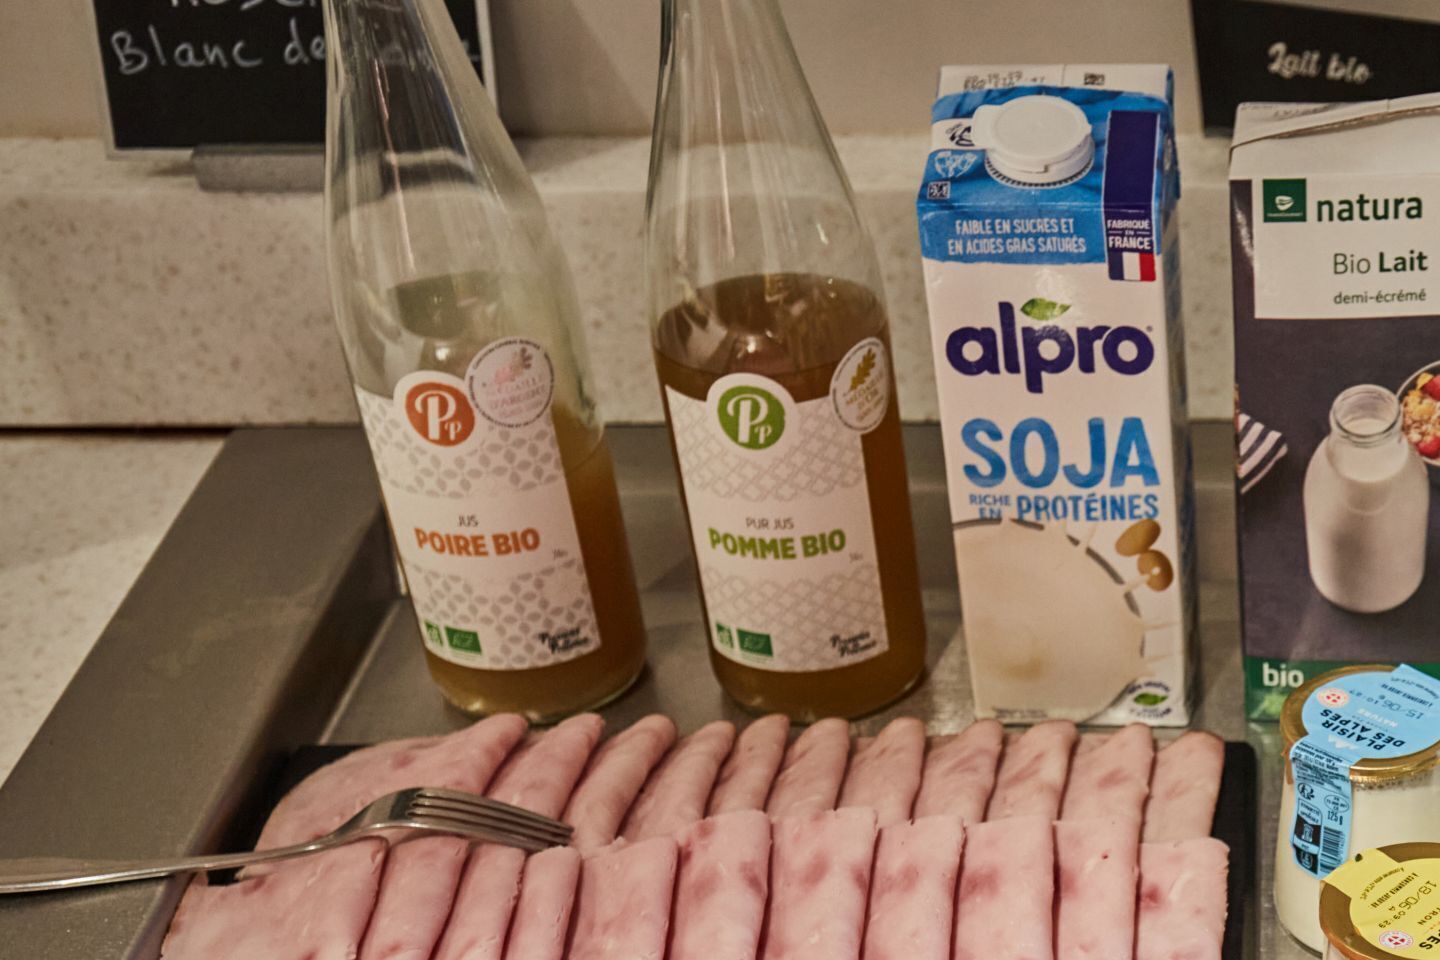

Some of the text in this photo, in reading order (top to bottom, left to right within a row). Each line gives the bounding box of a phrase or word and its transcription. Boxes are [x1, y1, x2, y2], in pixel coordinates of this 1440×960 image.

[110, 25, 263, 76] Blanc
[284, 17, 326, 65] de
[1326, 55, 1371, 84] bio
[1316, 196, 1424, 223] natura
[956, 217, 1075, 236] FAIBLE EN SUCRES ET
[1107, 218, 1151, 230] FABRIQUÉ
[948, 235, 1086, 256] EN ACIDES GRAS SATURÉS
[1109, 236, 1151, 250] FRANCE
[1333, 249, 1429, 275] Bio Lait
[1333, 288, 1427, 306] demi-écrémé
[946, 302, 1154, 394] alpro
[961, 417, 1160, 489] SOJA
[969, 494, 1011, 507] RICHE
[978, 507, 1002, 520] EN
[1016, 493, 1159, 522] PROTÉINES
[457, 515, 479, 528] JUS
[745, 517, 795, 530] PUR JUS
[414, 527, 489, 558] POIRE
[493, 528, 541, 556] BIO
[708, 527, 846, 560] POMME BIO
[1262, 662, 1305, 688] bio
[1320, 709, 1406, 747] DES ALPES
[1321, 720, 1386, 750] PLAISIR
[1398, 880, 1437, 913] 18/06
